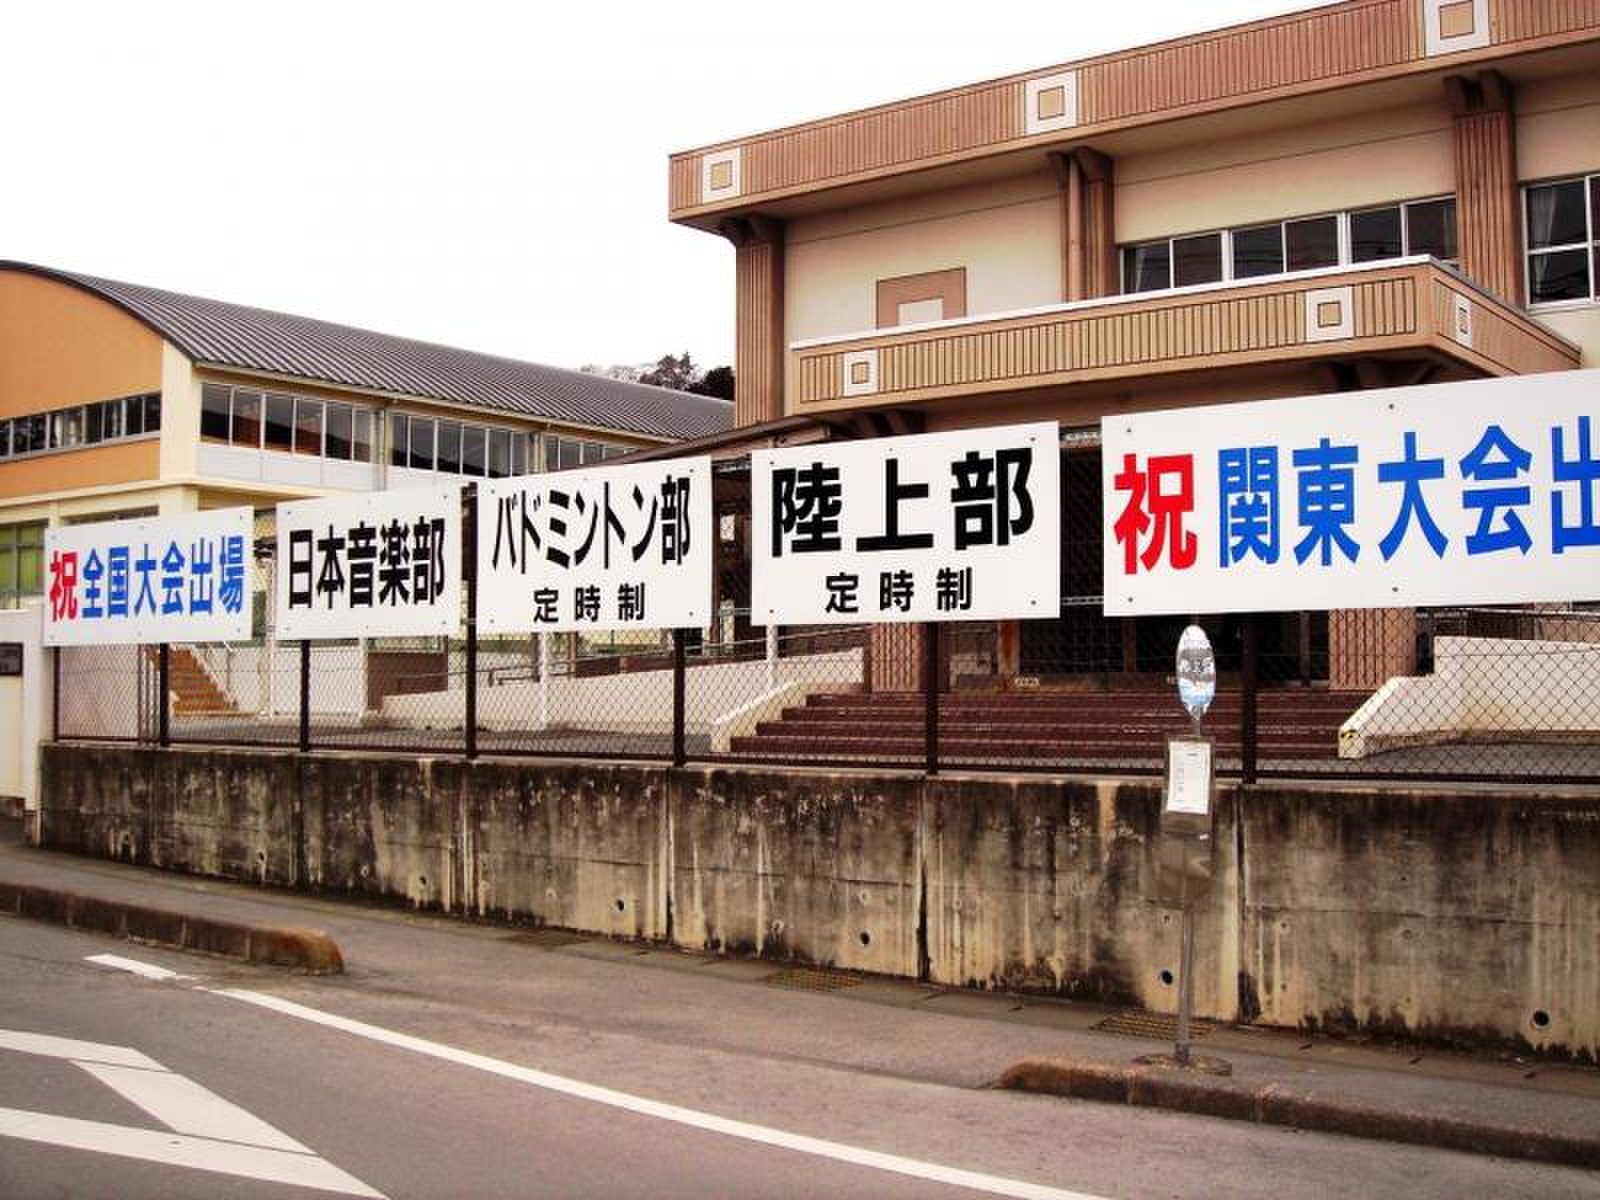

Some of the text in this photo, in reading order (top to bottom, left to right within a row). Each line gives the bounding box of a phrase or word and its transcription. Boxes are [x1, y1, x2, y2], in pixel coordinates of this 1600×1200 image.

[491, 474, 691, 574] バドミントン部
[771, 447, 1034, 558] 陸上部
[288, 516, 446, 610] 日本音楽部
[533, 582, 645, 623] 定時制
[824, 567, 973, 613] 定時制
